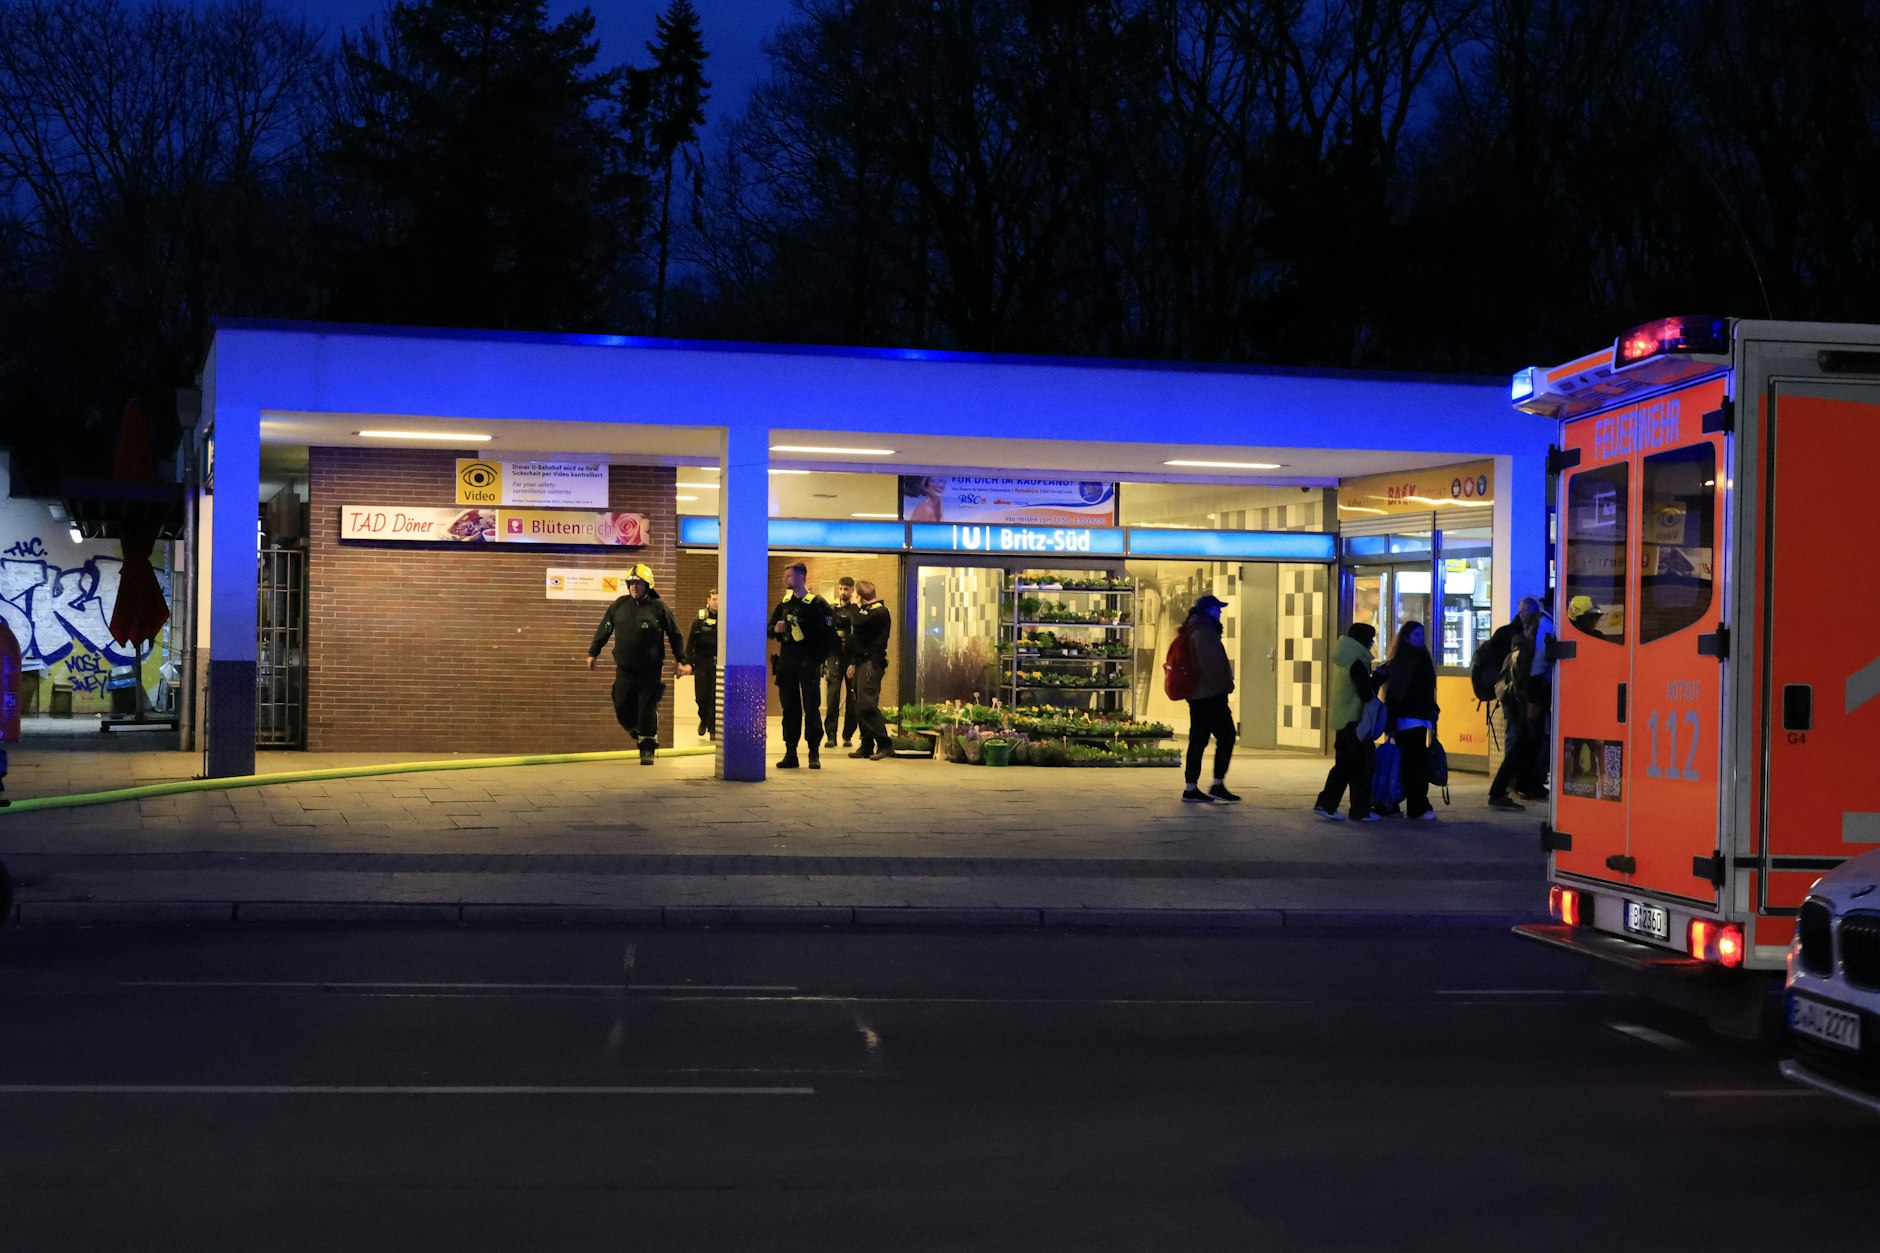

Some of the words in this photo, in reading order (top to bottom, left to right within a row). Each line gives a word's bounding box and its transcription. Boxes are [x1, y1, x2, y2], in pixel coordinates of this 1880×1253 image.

[1594, 398, 1681, 462] FEUERWEHR
[464, 490, 496, 502] Video
[351, 512, 387, 533] TAD
[392, 512, 434, 533] Döner
[532, 519, 612, 536] Blütenreich
[962, 526, 981, 550] U
[1000, 529, 1091, 552] Britz-Süd
[1646, 709, 1700, 782] 112
[1787, 733, 1807, 745] G4
[1642, 909, 1662, 932] 2360
